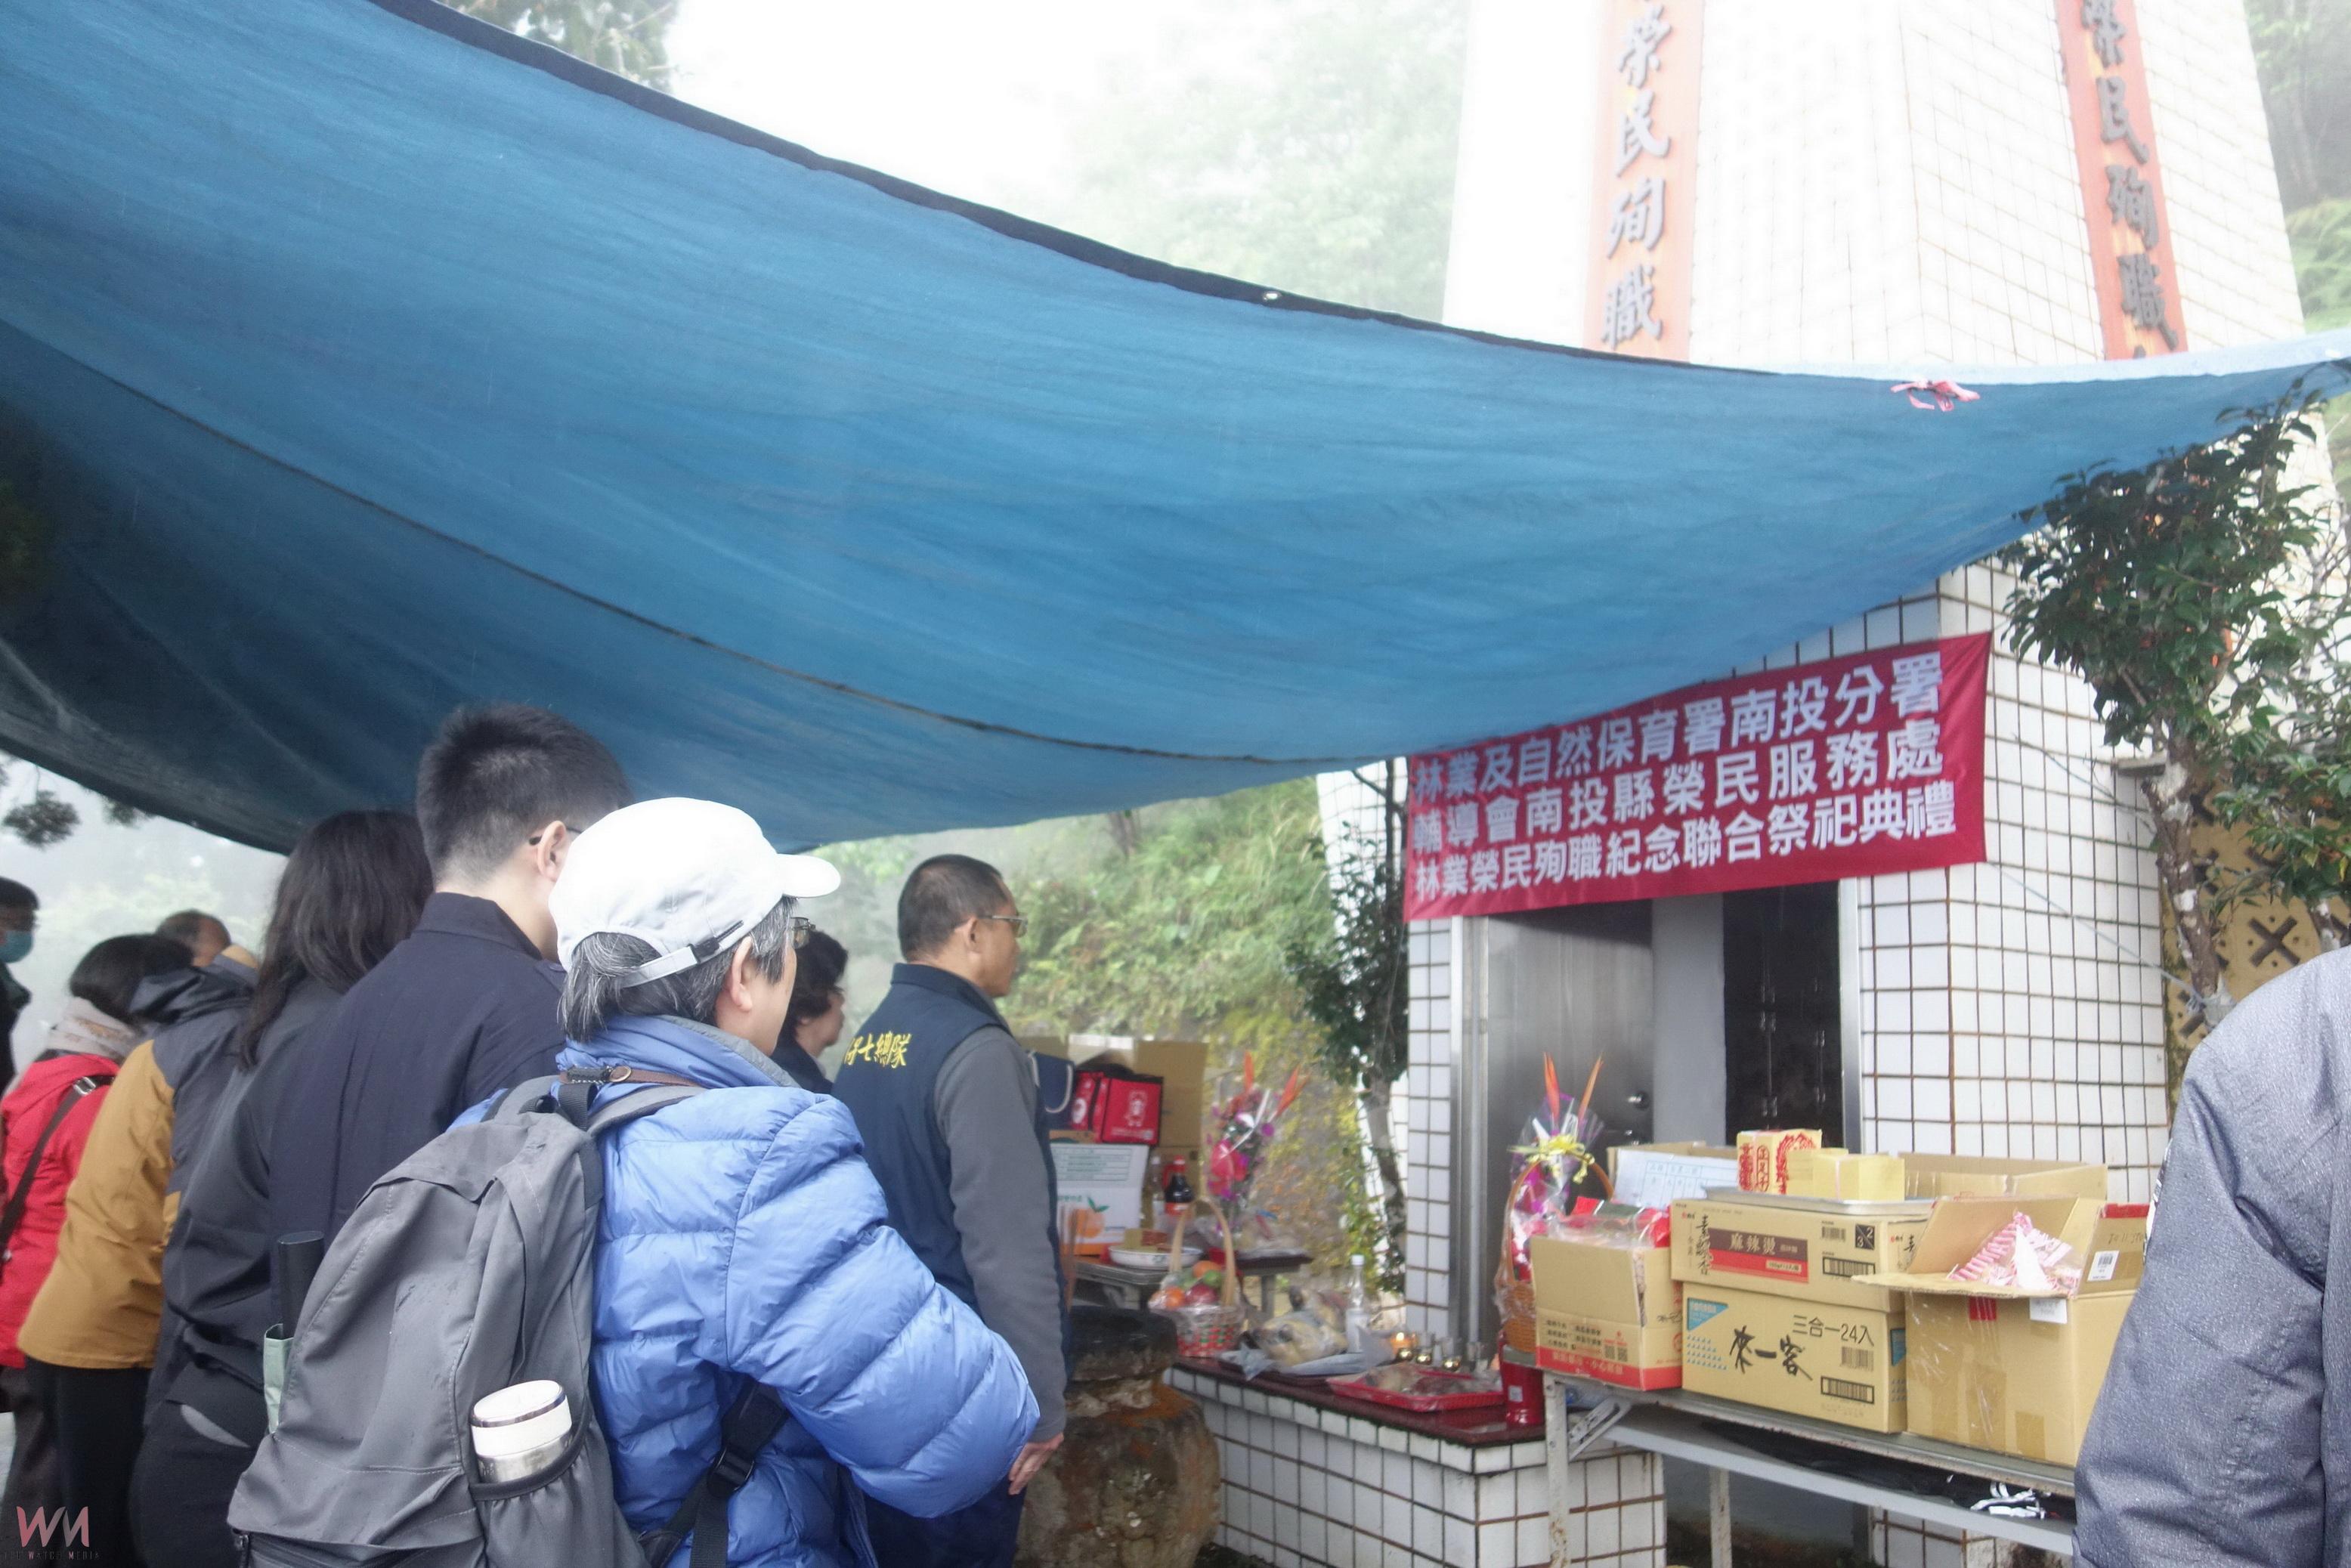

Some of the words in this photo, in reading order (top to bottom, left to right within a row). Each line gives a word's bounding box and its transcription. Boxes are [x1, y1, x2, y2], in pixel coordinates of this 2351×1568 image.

[2080, 0, 2179, 359] 榮民殉職
[1412, 719, 1944, 855] 輔導會南投縣榮民服務處
[1414, 651, 1944, 806] 林業及自然保育署南投分署
[1415, 780, 1957, 903] 林業榮民殉職紀念聯合祭祀典禮
[1792, 1313, 1875, 1347] 三合一24入
